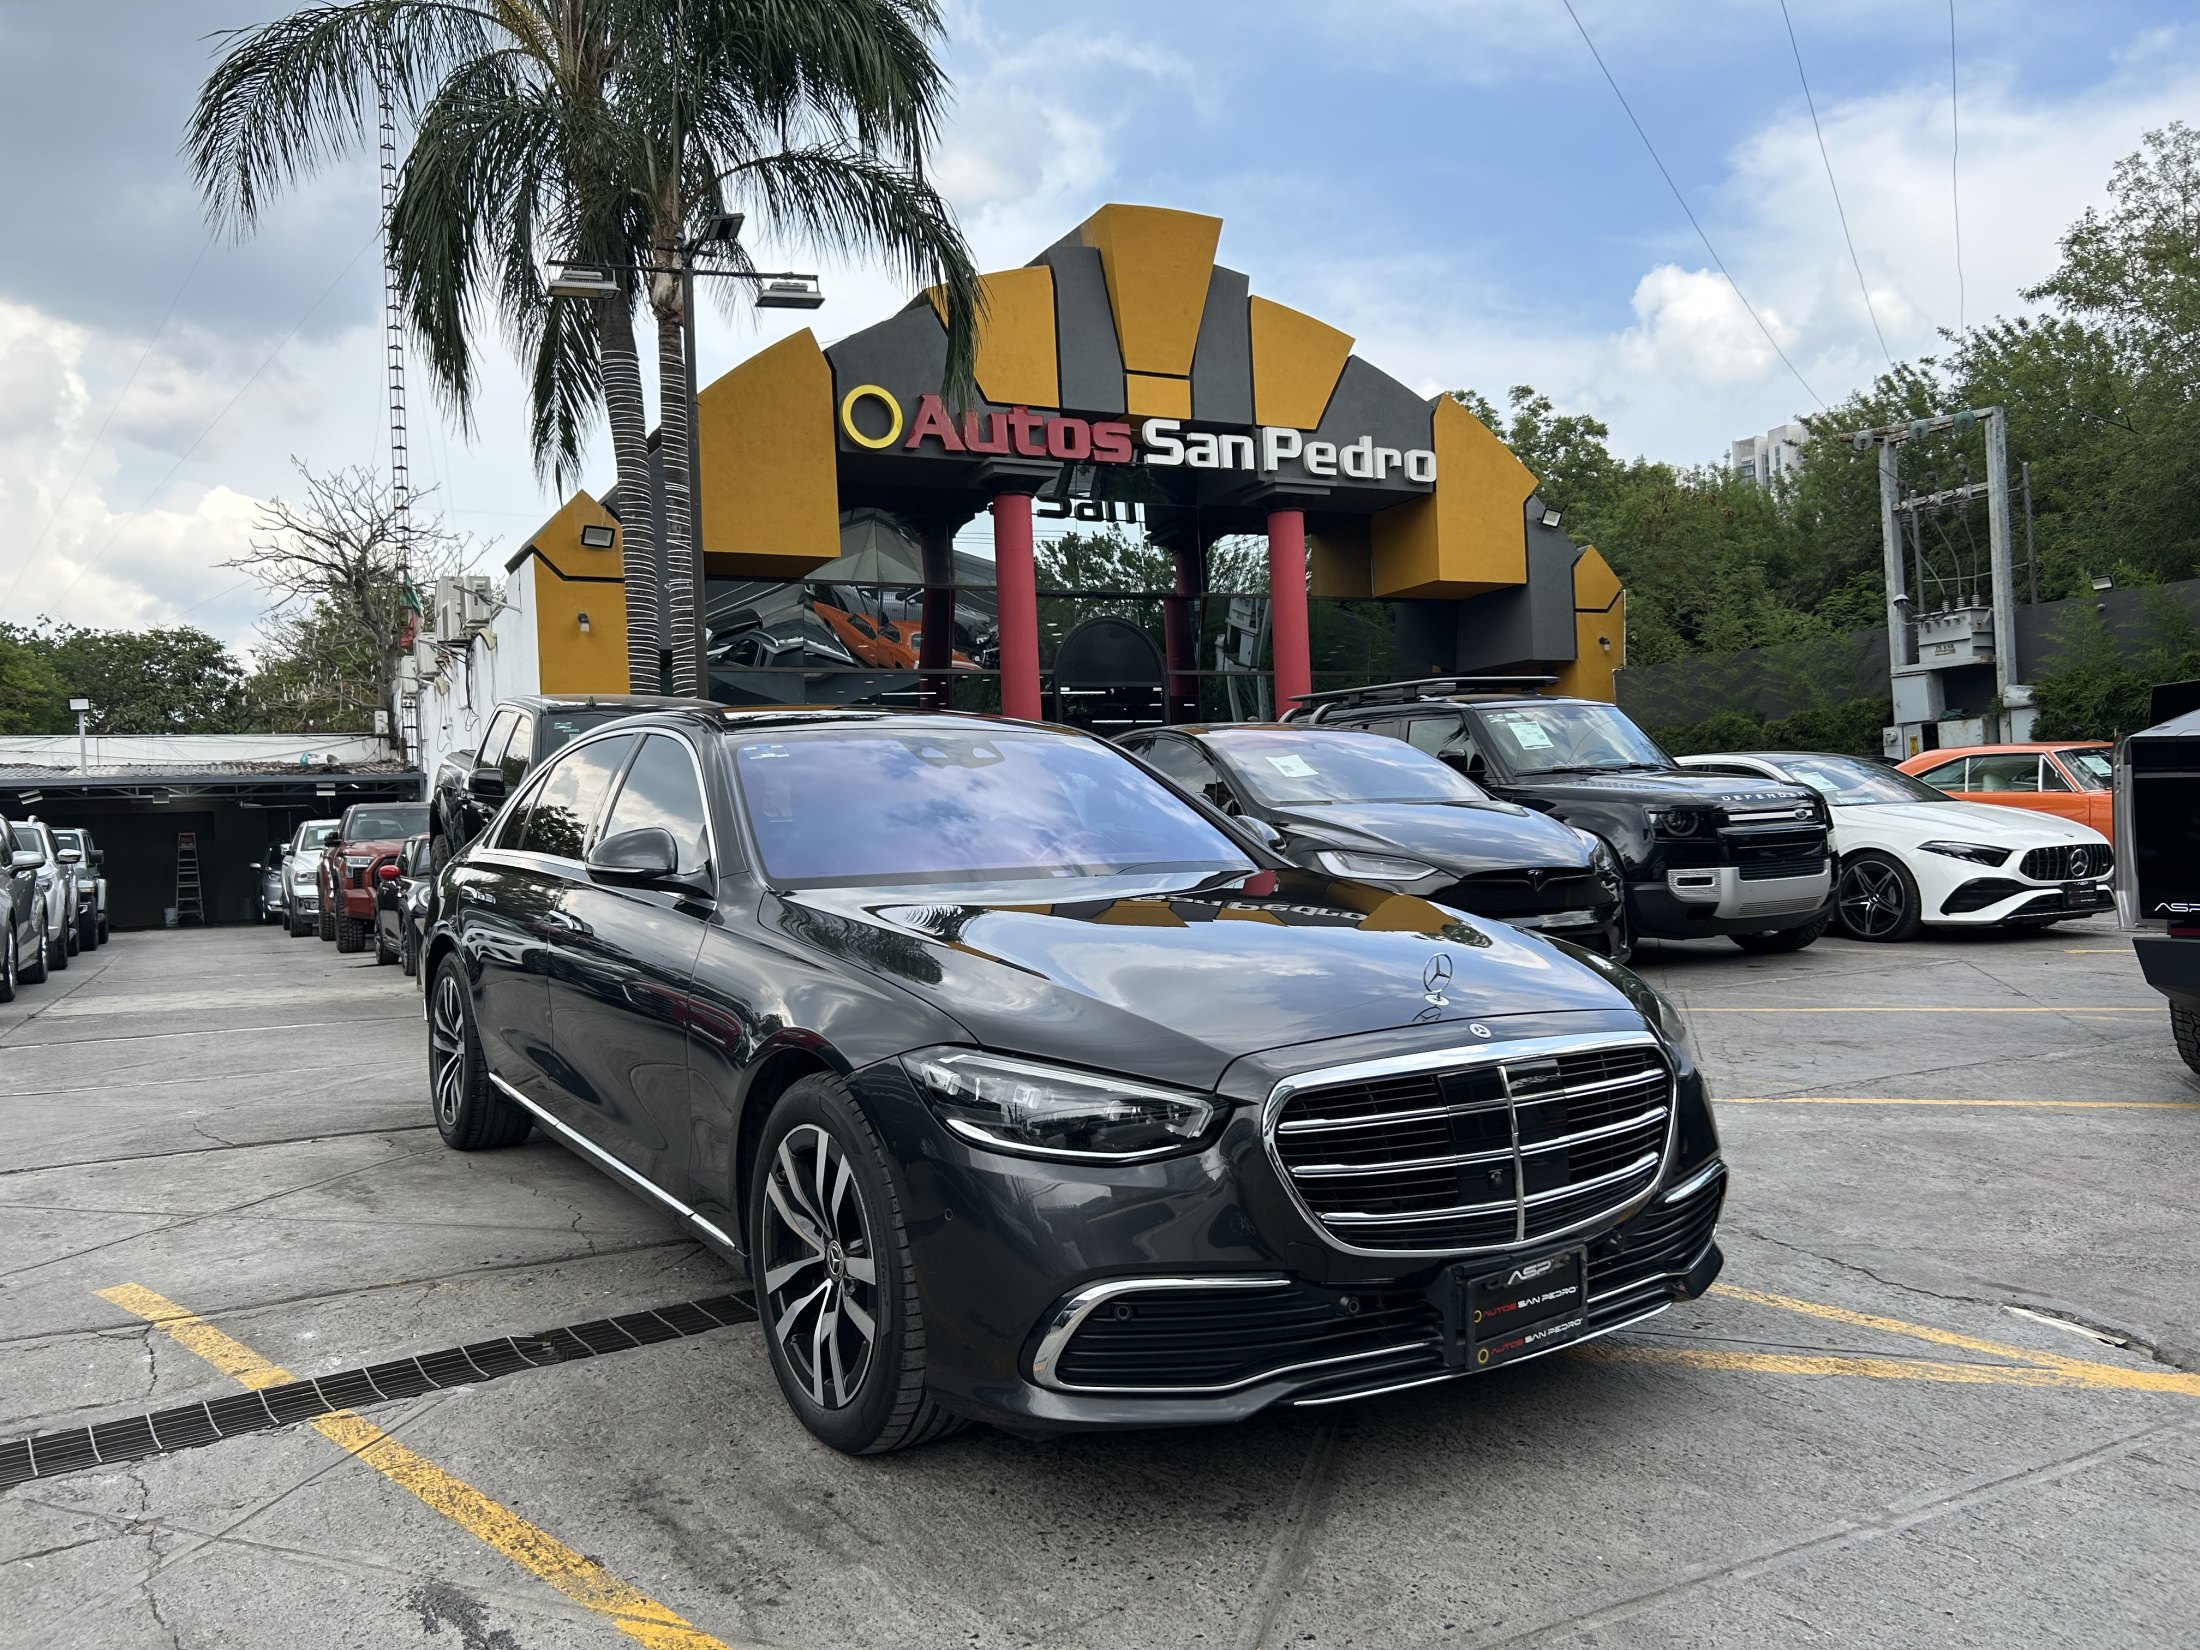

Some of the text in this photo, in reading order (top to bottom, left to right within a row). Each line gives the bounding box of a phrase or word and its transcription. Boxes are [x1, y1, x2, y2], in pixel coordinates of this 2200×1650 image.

[904, 393, 1437, 483] Autos San Pedro
[1721, 791, 1807, 801] DEFENDER
[1507, 1260, 1552, 1286] ASP
[1483, 1286, 1577, 1317] AUTOS SAN PEDRO
[1491, 1318, 1582, 1355] AUTOS SAN PEDRO
